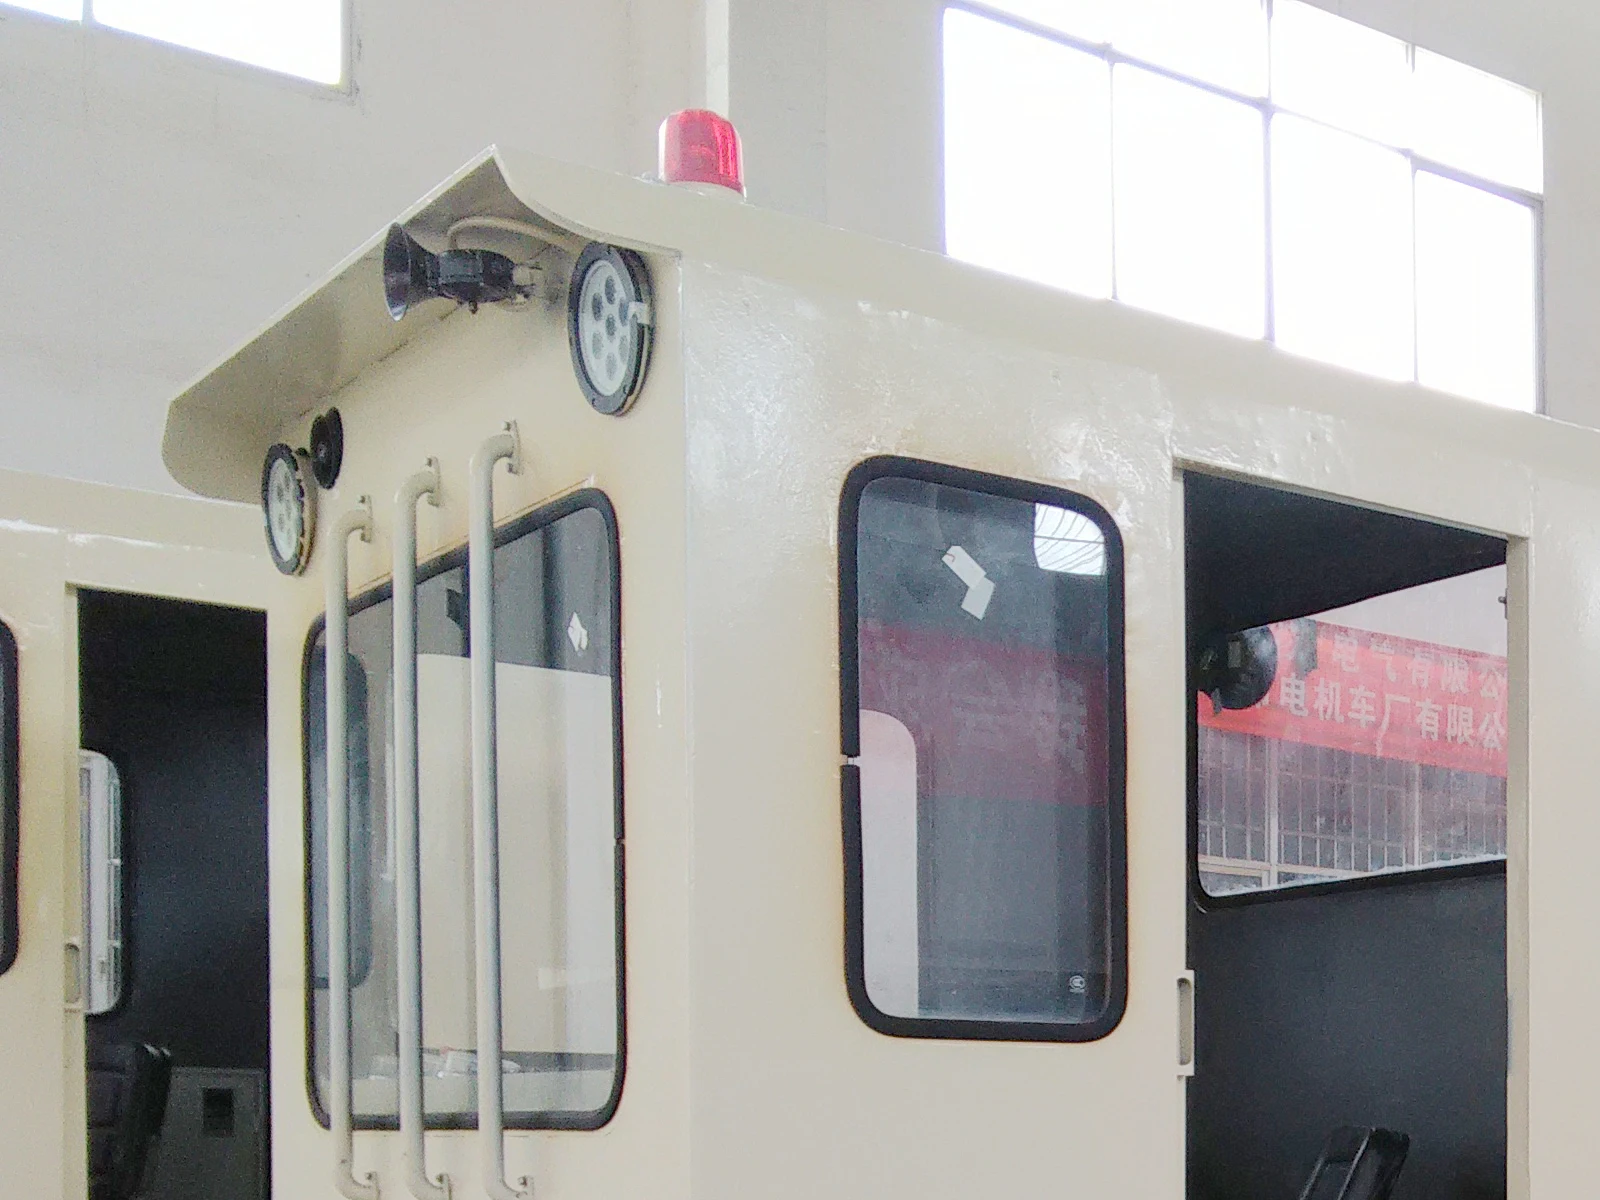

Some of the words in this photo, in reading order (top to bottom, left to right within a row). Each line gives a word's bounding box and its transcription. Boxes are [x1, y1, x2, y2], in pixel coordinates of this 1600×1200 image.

[1255, 674, 1506, 752] 电机车厂有限公
